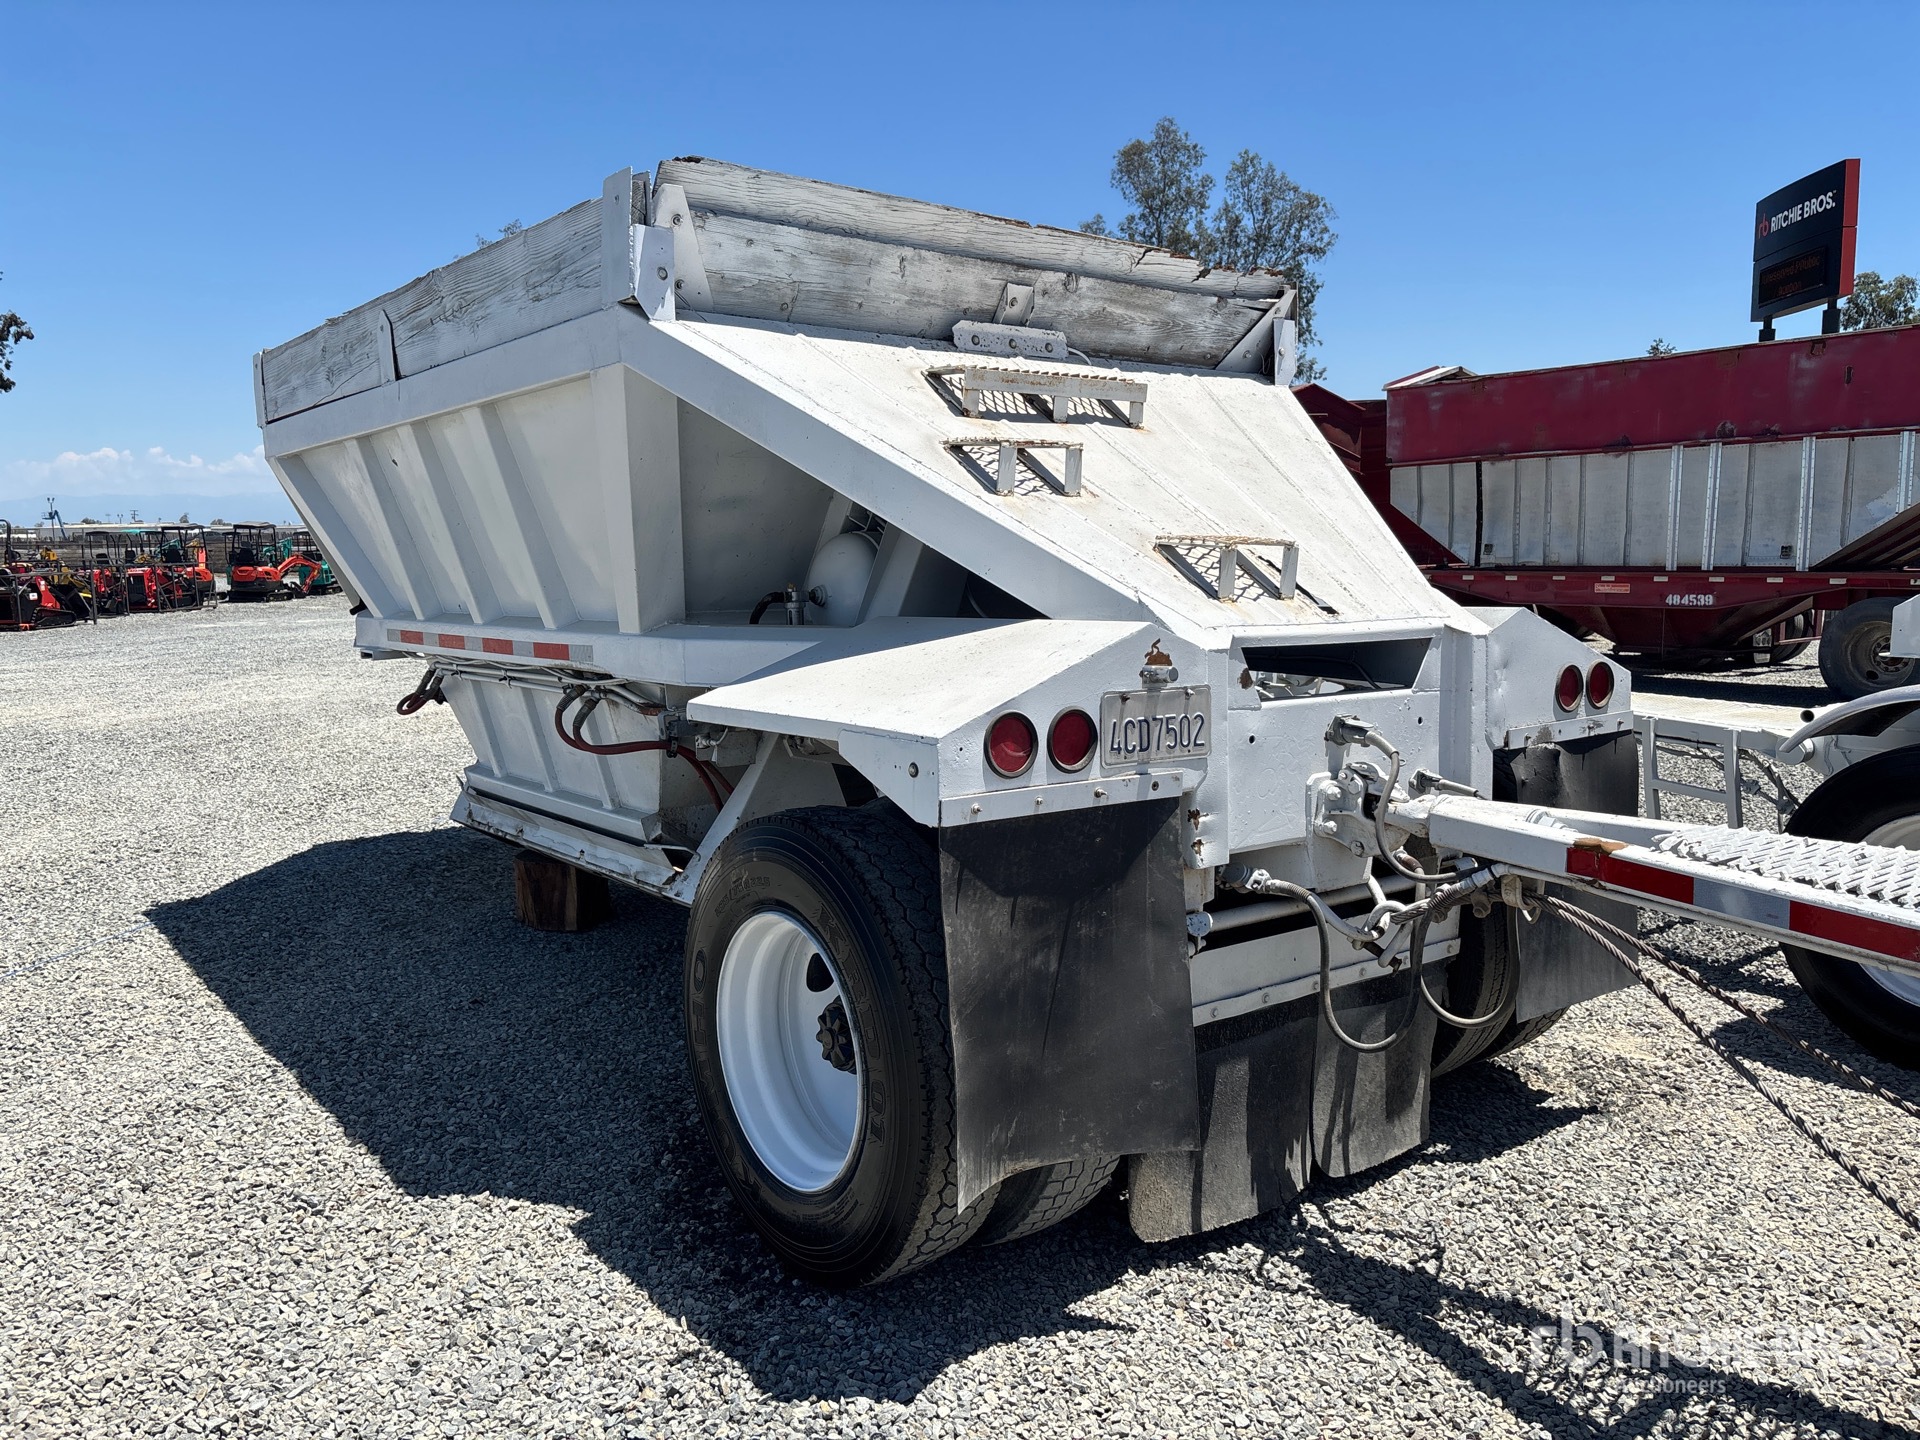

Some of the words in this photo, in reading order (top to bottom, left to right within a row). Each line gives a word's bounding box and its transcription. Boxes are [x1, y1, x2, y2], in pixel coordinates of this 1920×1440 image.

[1770, 204, 1803, 233] RITCHIE
[1665, 593, 1714, 606] 484539
[1110, 712, 1206, 755] 4CD7502
[692, 947, 764, 1207] KUMHO
